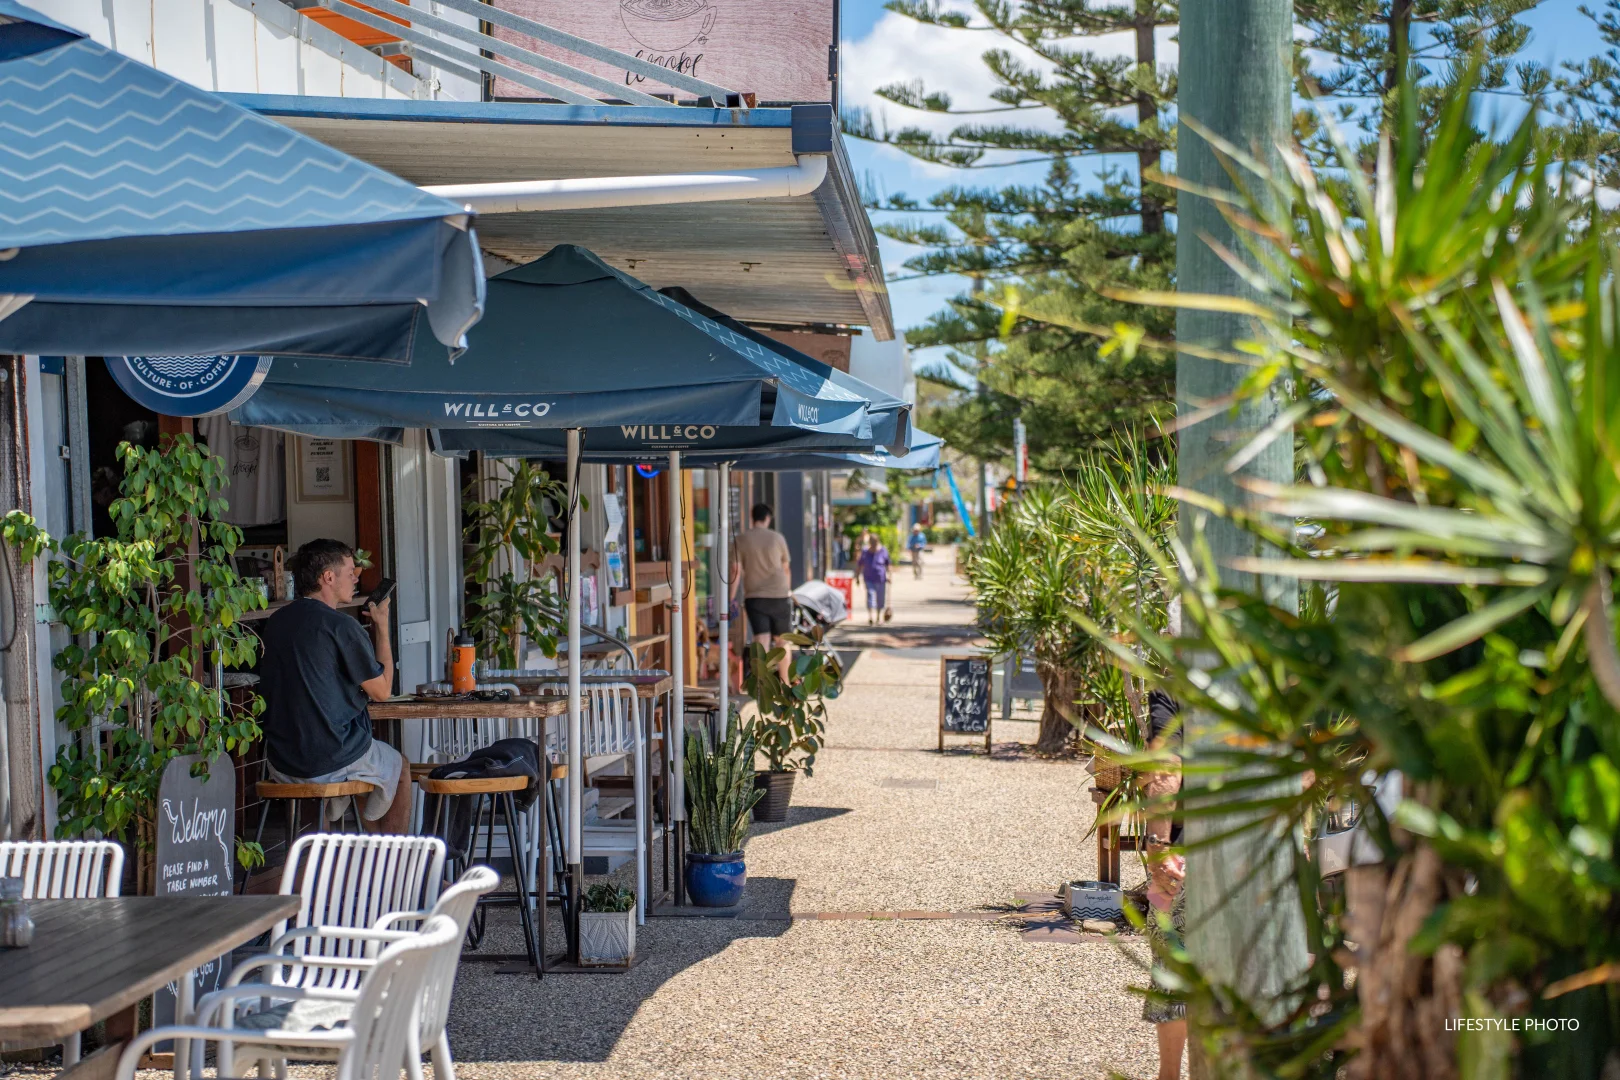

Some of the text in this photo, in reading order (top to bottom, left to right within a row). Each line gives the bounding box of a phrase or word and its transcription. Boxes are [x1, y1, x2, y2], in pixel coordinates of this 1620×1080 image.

[133, 355, 230, 390] CULTURE OF COFFEE
[162, 797, 227, 844] Welcome
[162, 858, 209, 880] PLEASE FIND A
[166, 874, 218, 893] TABLE NUMBER
